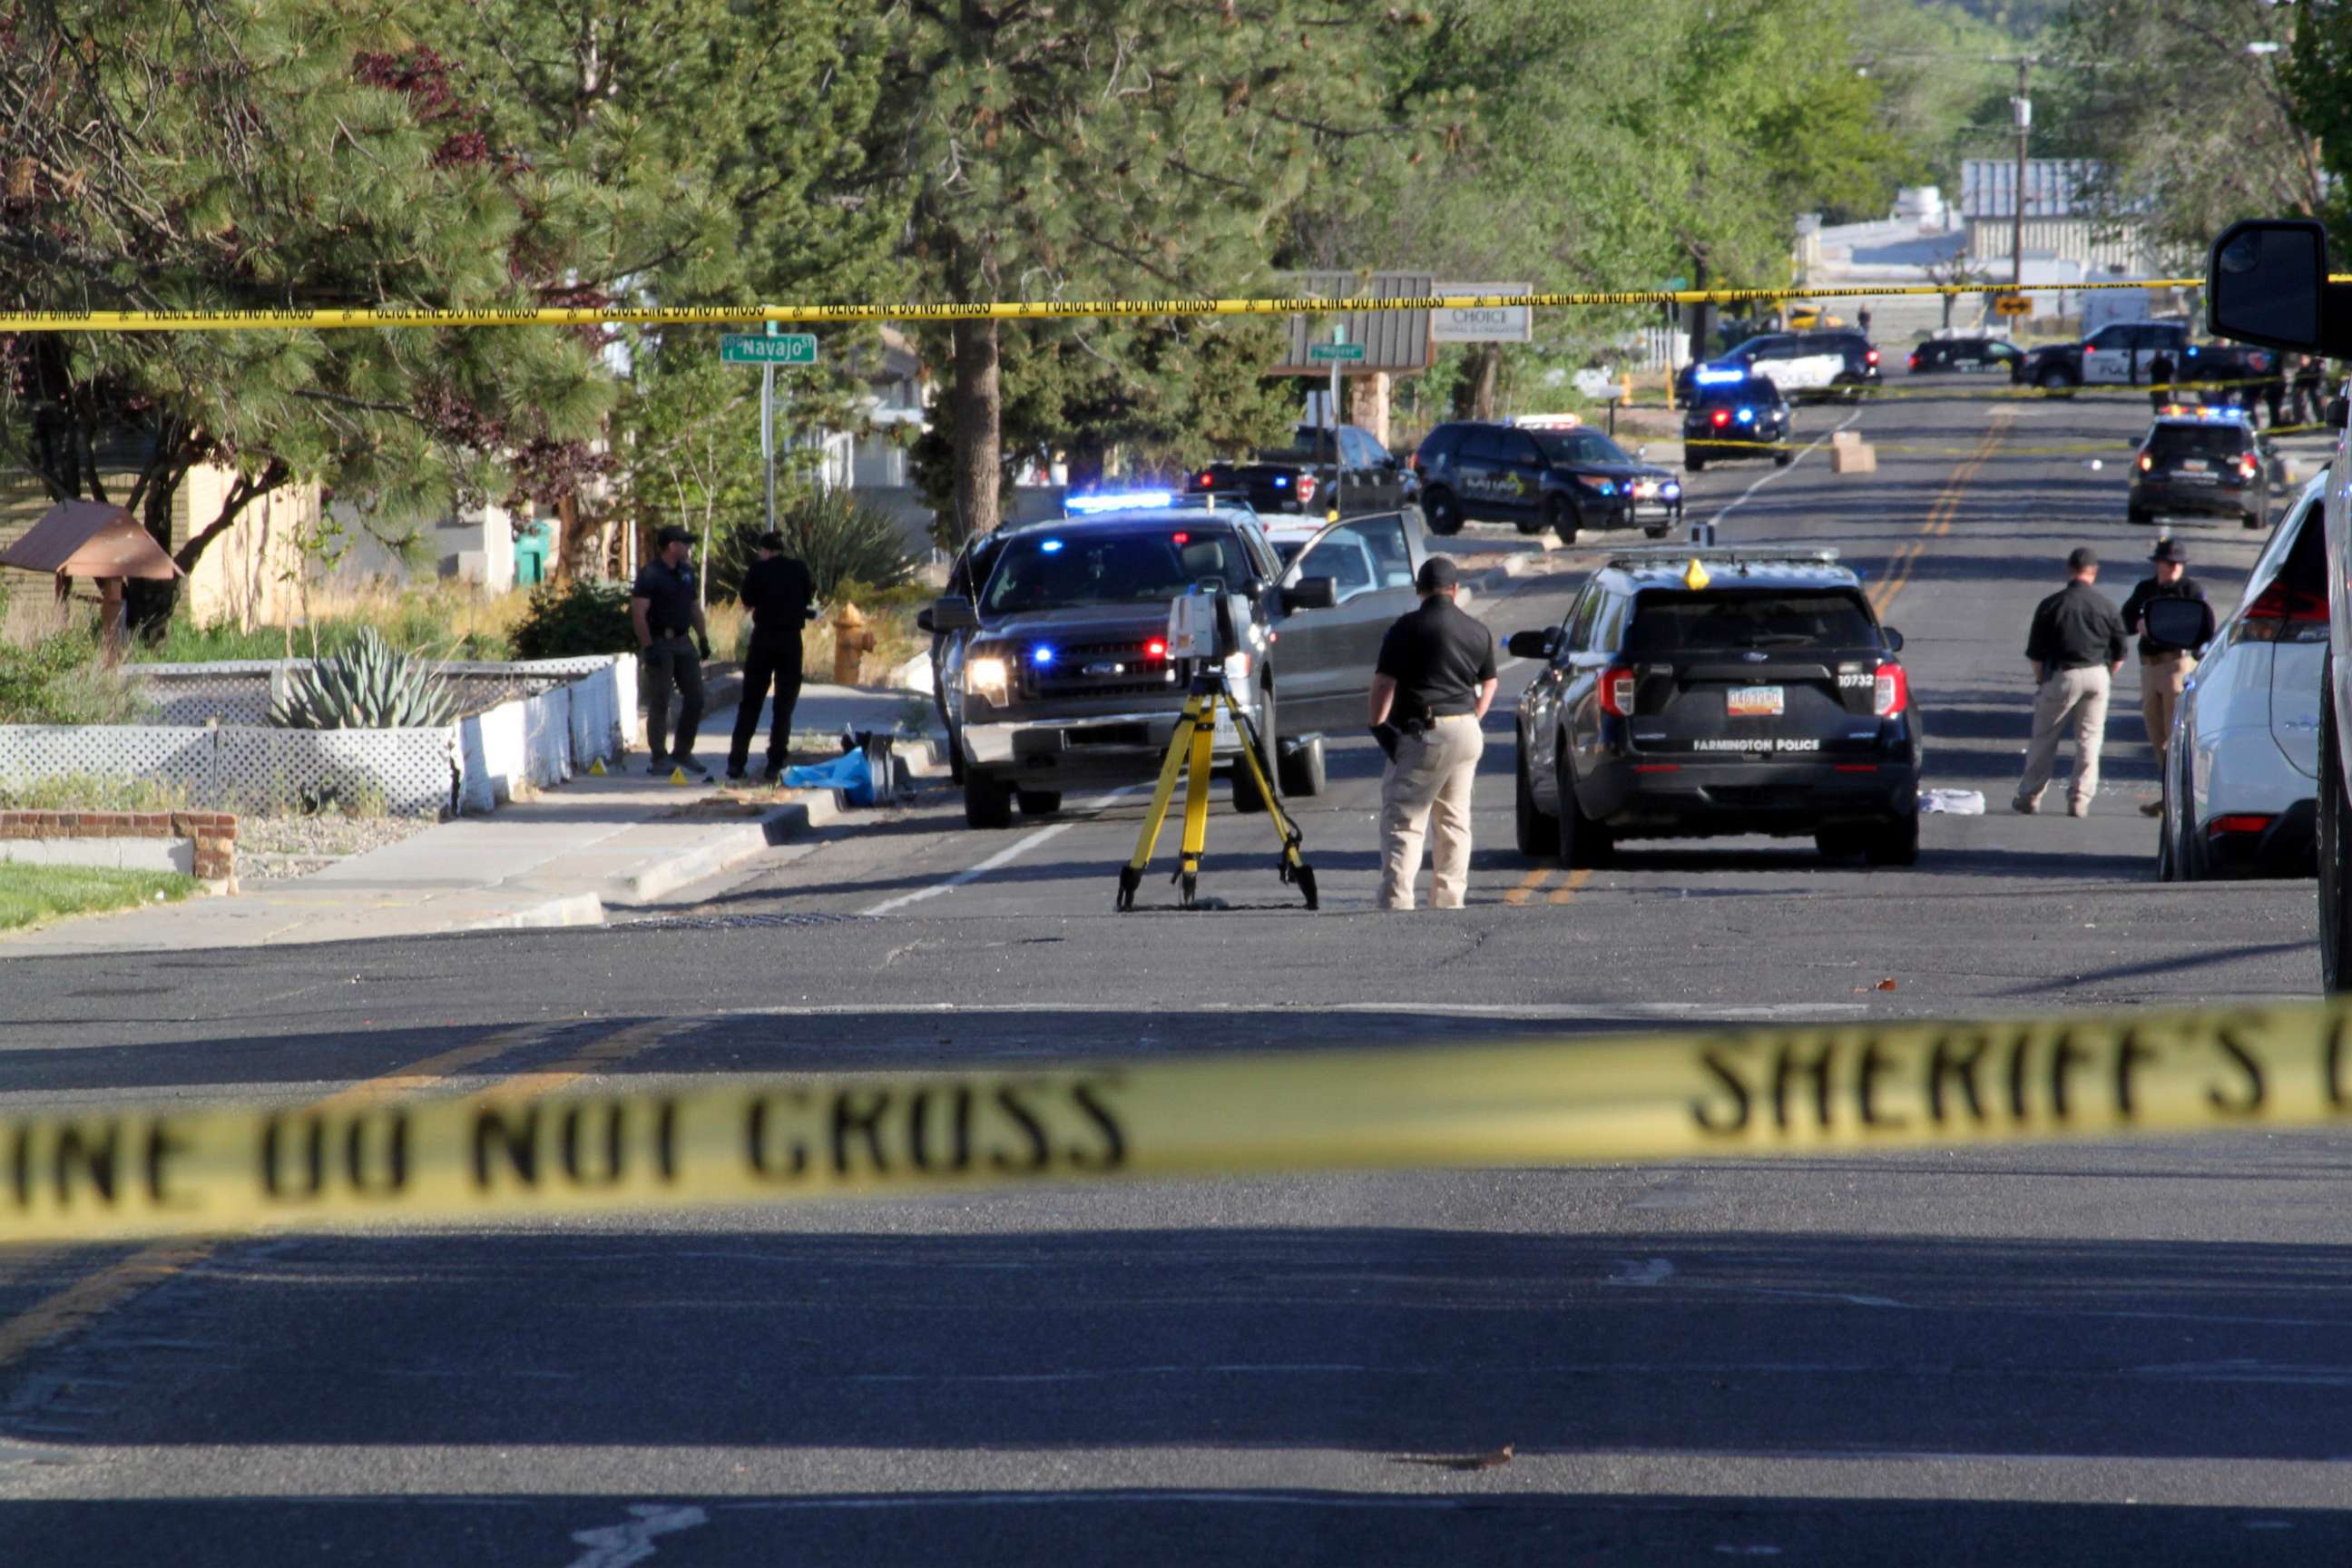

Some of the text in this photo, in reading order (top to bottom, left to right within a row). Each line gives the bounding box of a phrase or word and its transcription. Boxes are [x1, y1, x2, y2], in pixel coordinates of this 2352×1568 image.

[743, 338, 802, 361] Navajo
[1838, 673, 1874, 688] 10732
[1693, 739, 1820, 751] FARMINGTON POLICE
[1691, 1009, 2266, 1134] SHERIFF'S
[11, 1116, 192, 1212] INE
[745, 1073, 1126, 1178] CROSS
